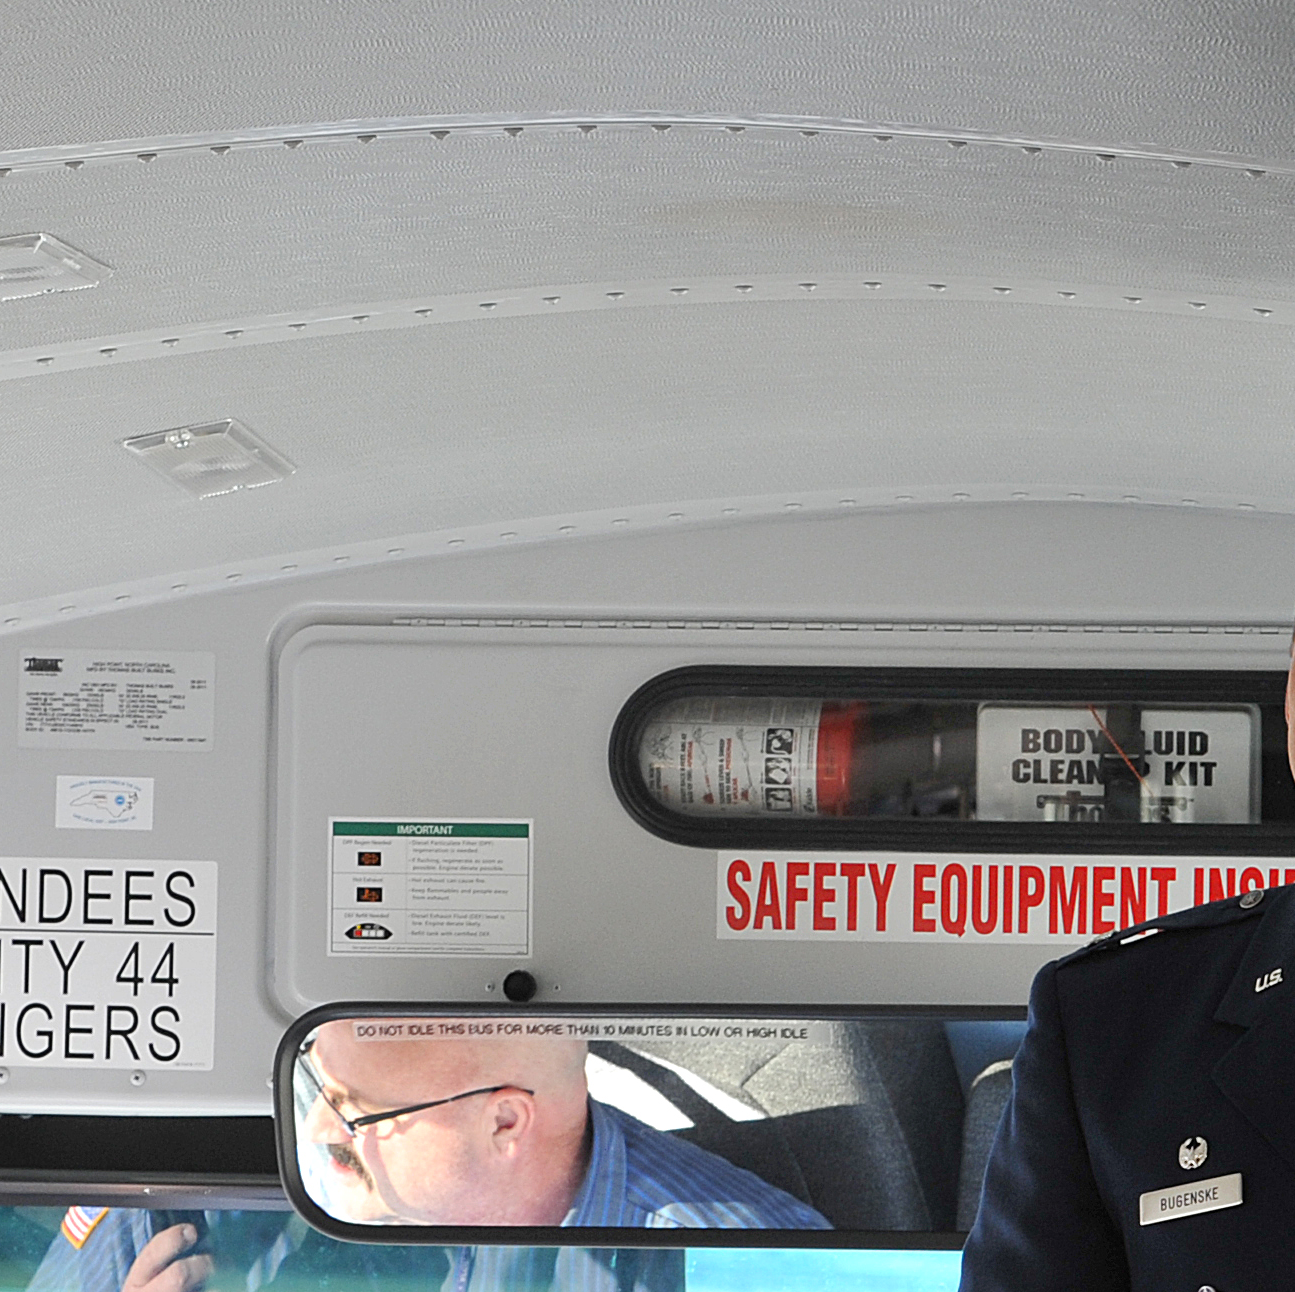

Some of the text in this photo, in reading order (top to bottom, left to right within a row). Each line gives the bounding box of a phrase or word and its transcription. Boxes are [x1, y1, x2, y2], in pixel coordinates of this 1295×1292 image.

[1165, 761, 1218, 787] KIT
[397, 825, 453, 835] IMPORTANT
[726, 859, 897, 932] SAFETY
[913, 863, 1177, 937] EQUIPMENT
[115, 941, 179, 998] 44
[357, 1024, 809, 1040] DO NOT IDLE THIS BUS FOR MORE THAN 10 MINUTES IN LOW OR HIGH IDLE
[1160, 1186, 1219, 1212] BUGENSKE
